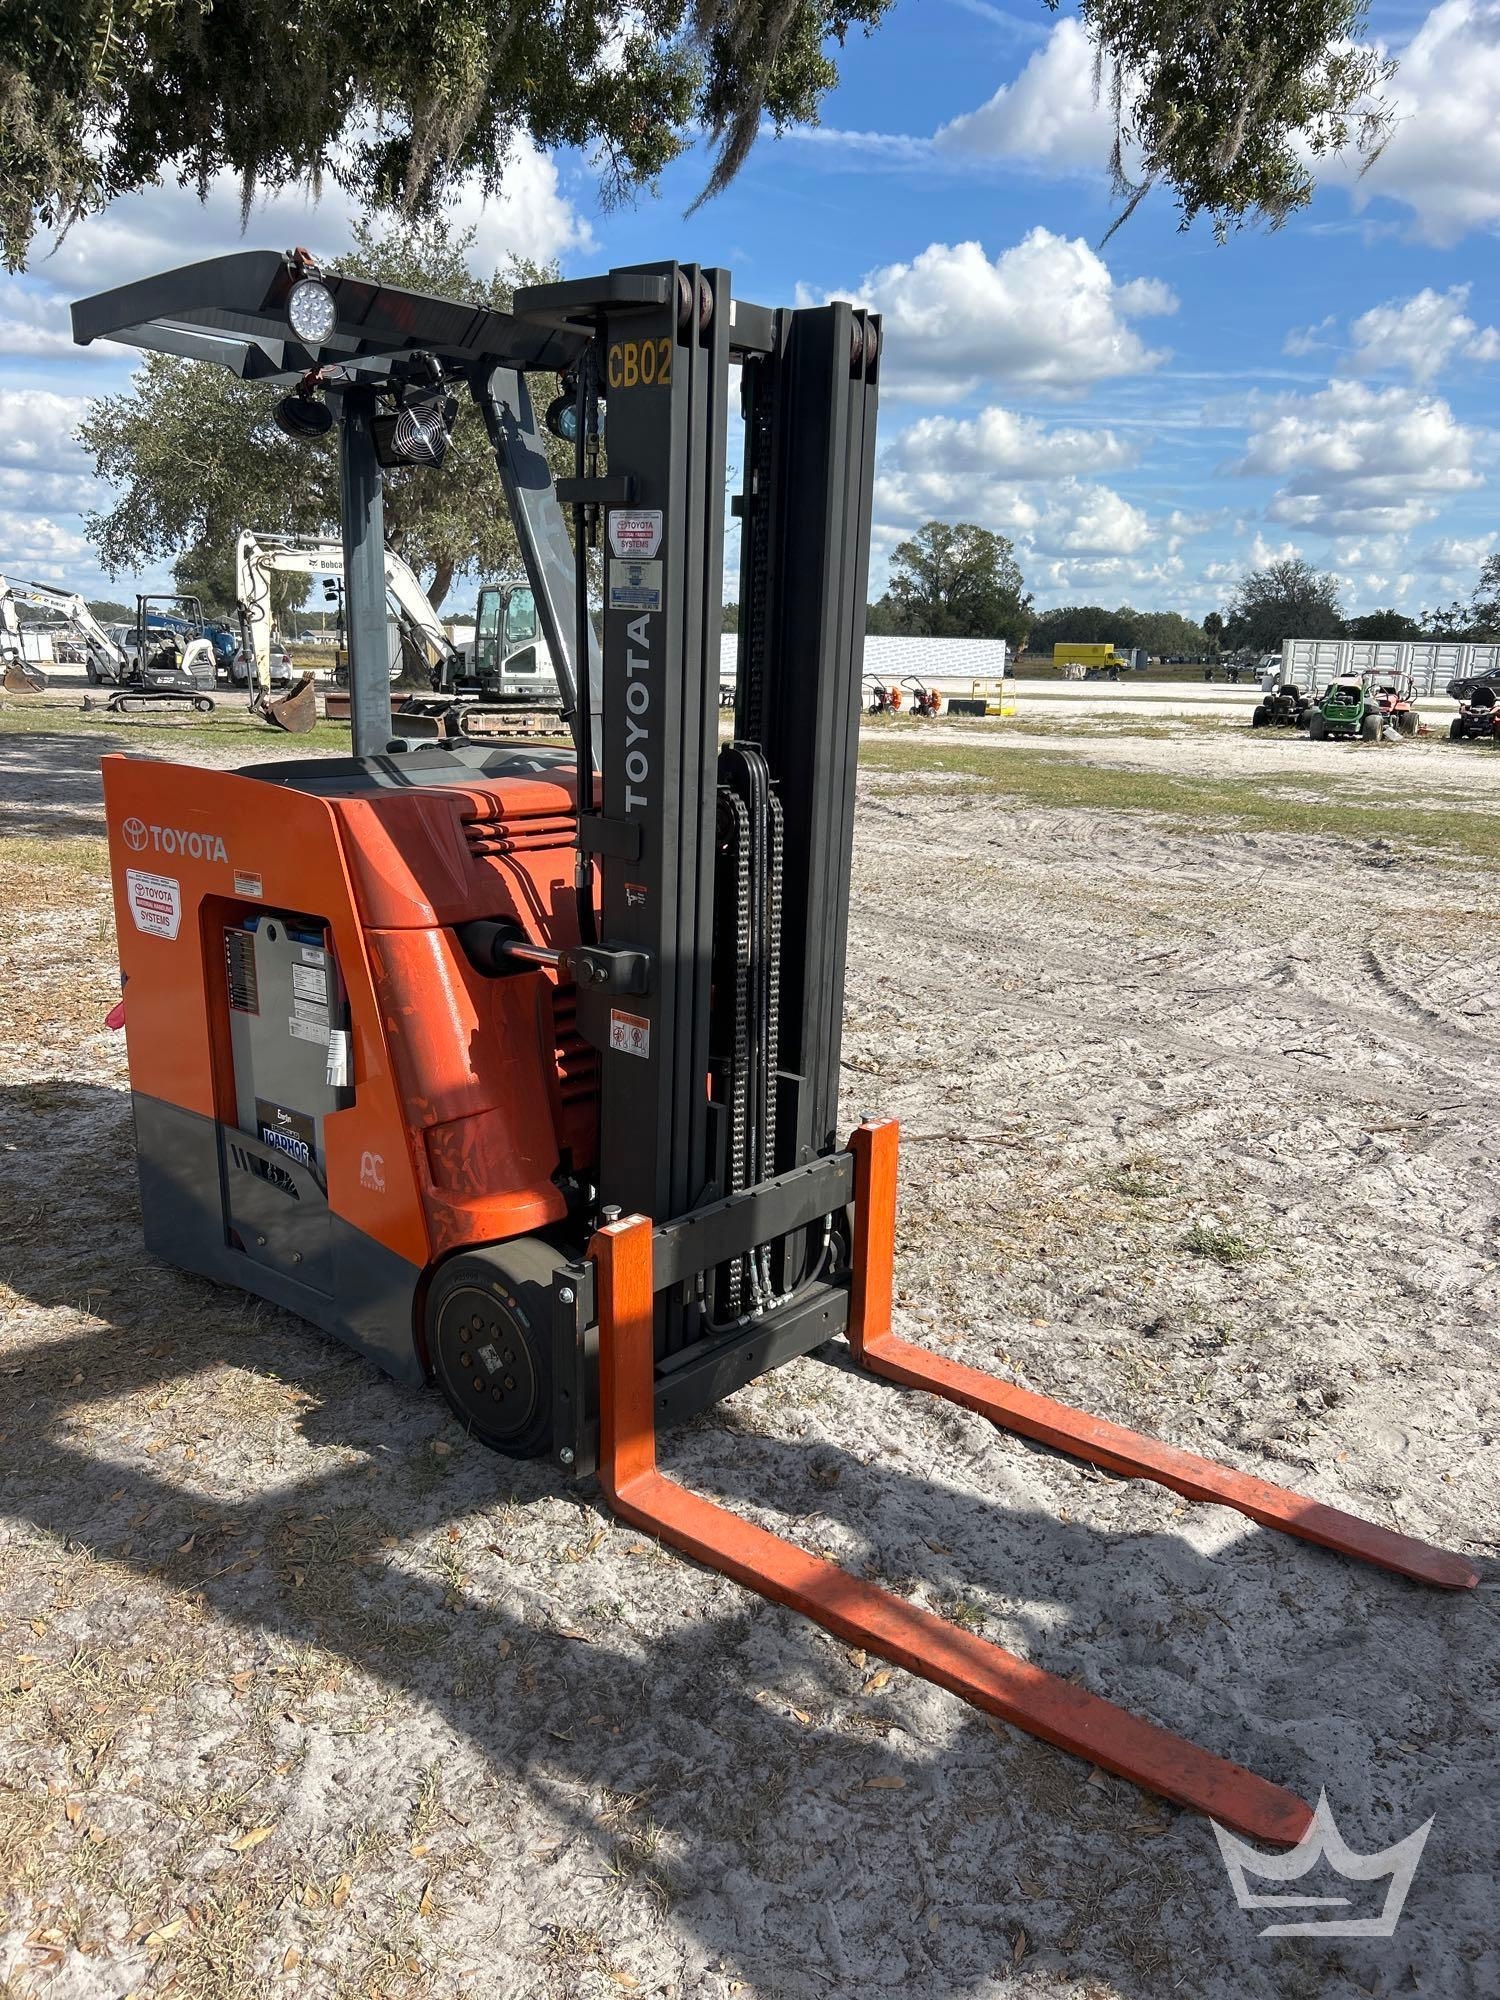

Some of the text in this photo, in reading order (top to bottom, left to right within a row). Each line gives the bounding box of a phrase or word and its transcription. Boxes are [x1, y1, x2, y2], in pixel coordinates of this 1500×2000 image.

[608, 338, 672, 388] CB02
[627, 521, 653, 529] TOYOTA
[320, 561, 343, 569] Bobca
[625, 613, 650, 813] TOYOTA
[150, 826, 229, 864] TOYOTA
[145, 887, 173, 902] TOYOTA
[140, 911, 170, 926] SYSTEMS
